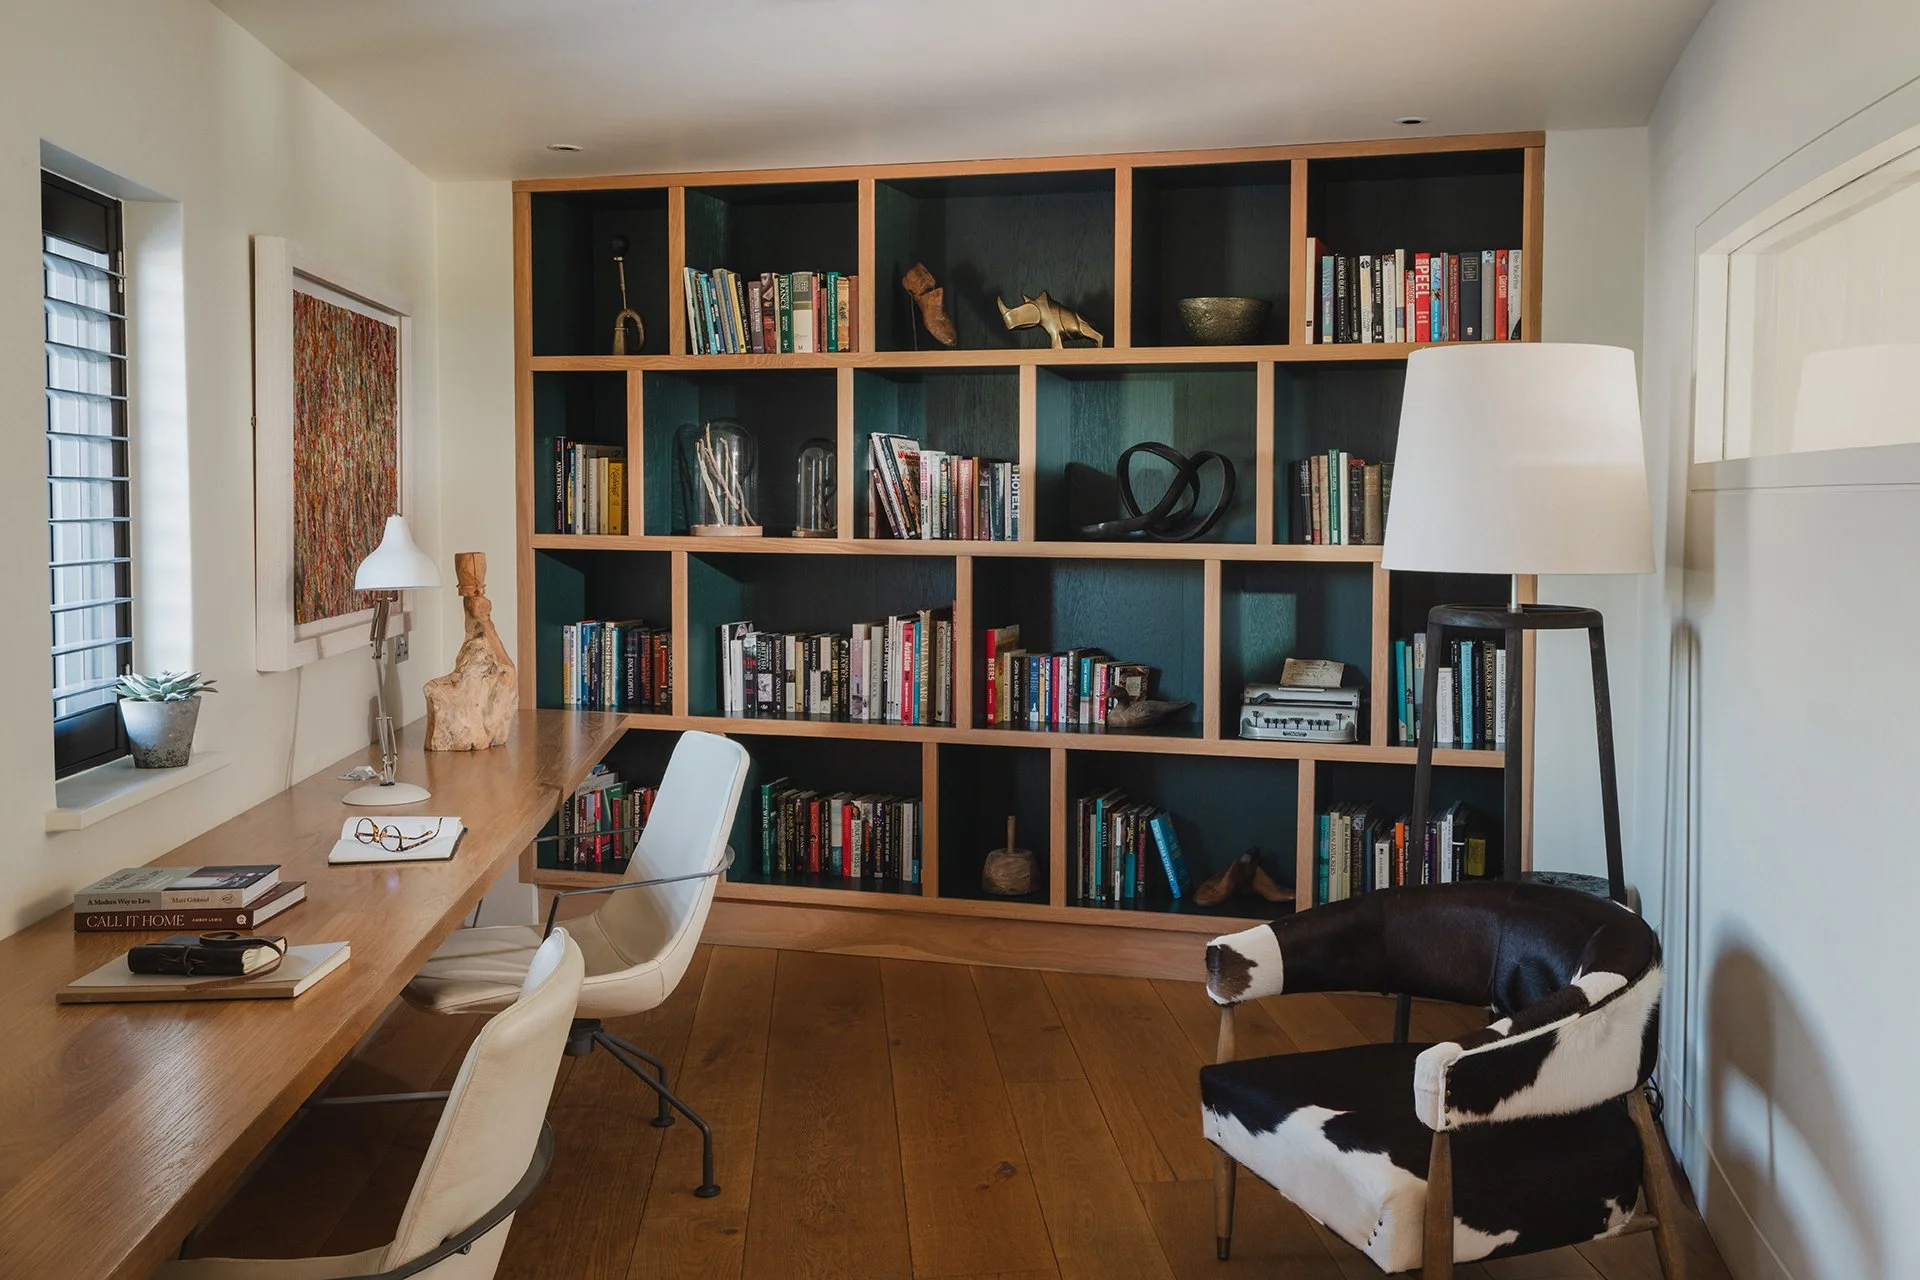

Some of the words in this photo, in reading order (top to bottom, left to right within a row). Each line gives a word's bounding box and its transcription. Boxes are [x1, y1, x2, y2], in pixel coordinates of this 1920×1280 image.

[1338, 257, 1346, 280] LAURENCE
[780, 278, 788, 310] FRANCE
[1322, 269, 1331, 298] WREN
[1415, 265, 1430, 299] PEEL
[1498, 275, 1507, 299] Clarkson
[1011, 473, 1020, 509] HOTEL
[903, 641, 913, 671] Aviation
[920, 630, 929, 658] CIVIL
[920, 658, 929, 682] WAR
[920, 683, 928, 704] ART
[1163, 858, 1174, 882] STRATEGY
[117, 898, 130, 906] Way
[86, 915, 123, 928] CALL
[126, 915, 140, 927] IT
[142, 914, 185, 927] HOME
